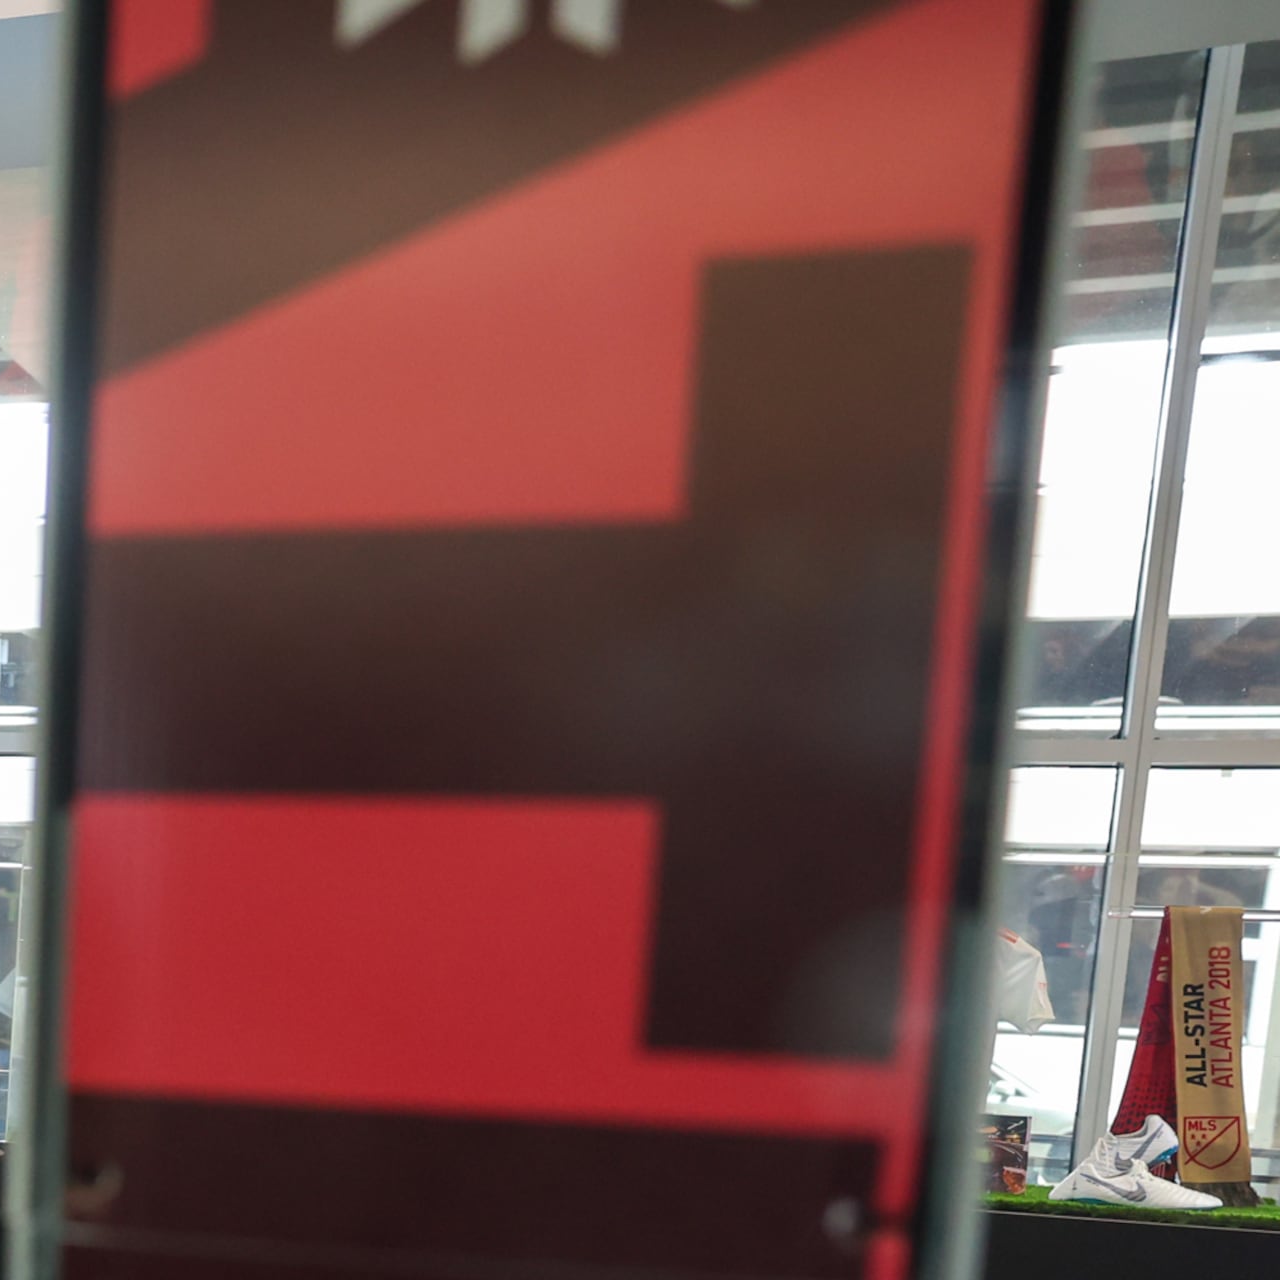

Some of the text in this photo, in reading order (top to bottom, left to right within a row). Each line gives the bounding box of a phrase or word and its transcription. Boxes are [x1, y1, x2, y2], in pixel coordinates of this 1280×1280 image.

[1183, 983, 1208, 1088] ALL-STAR
[1208, 945, 1234, 1088] ATLANTA 2018
[1187, 1120, 1217, 1131] MLS
